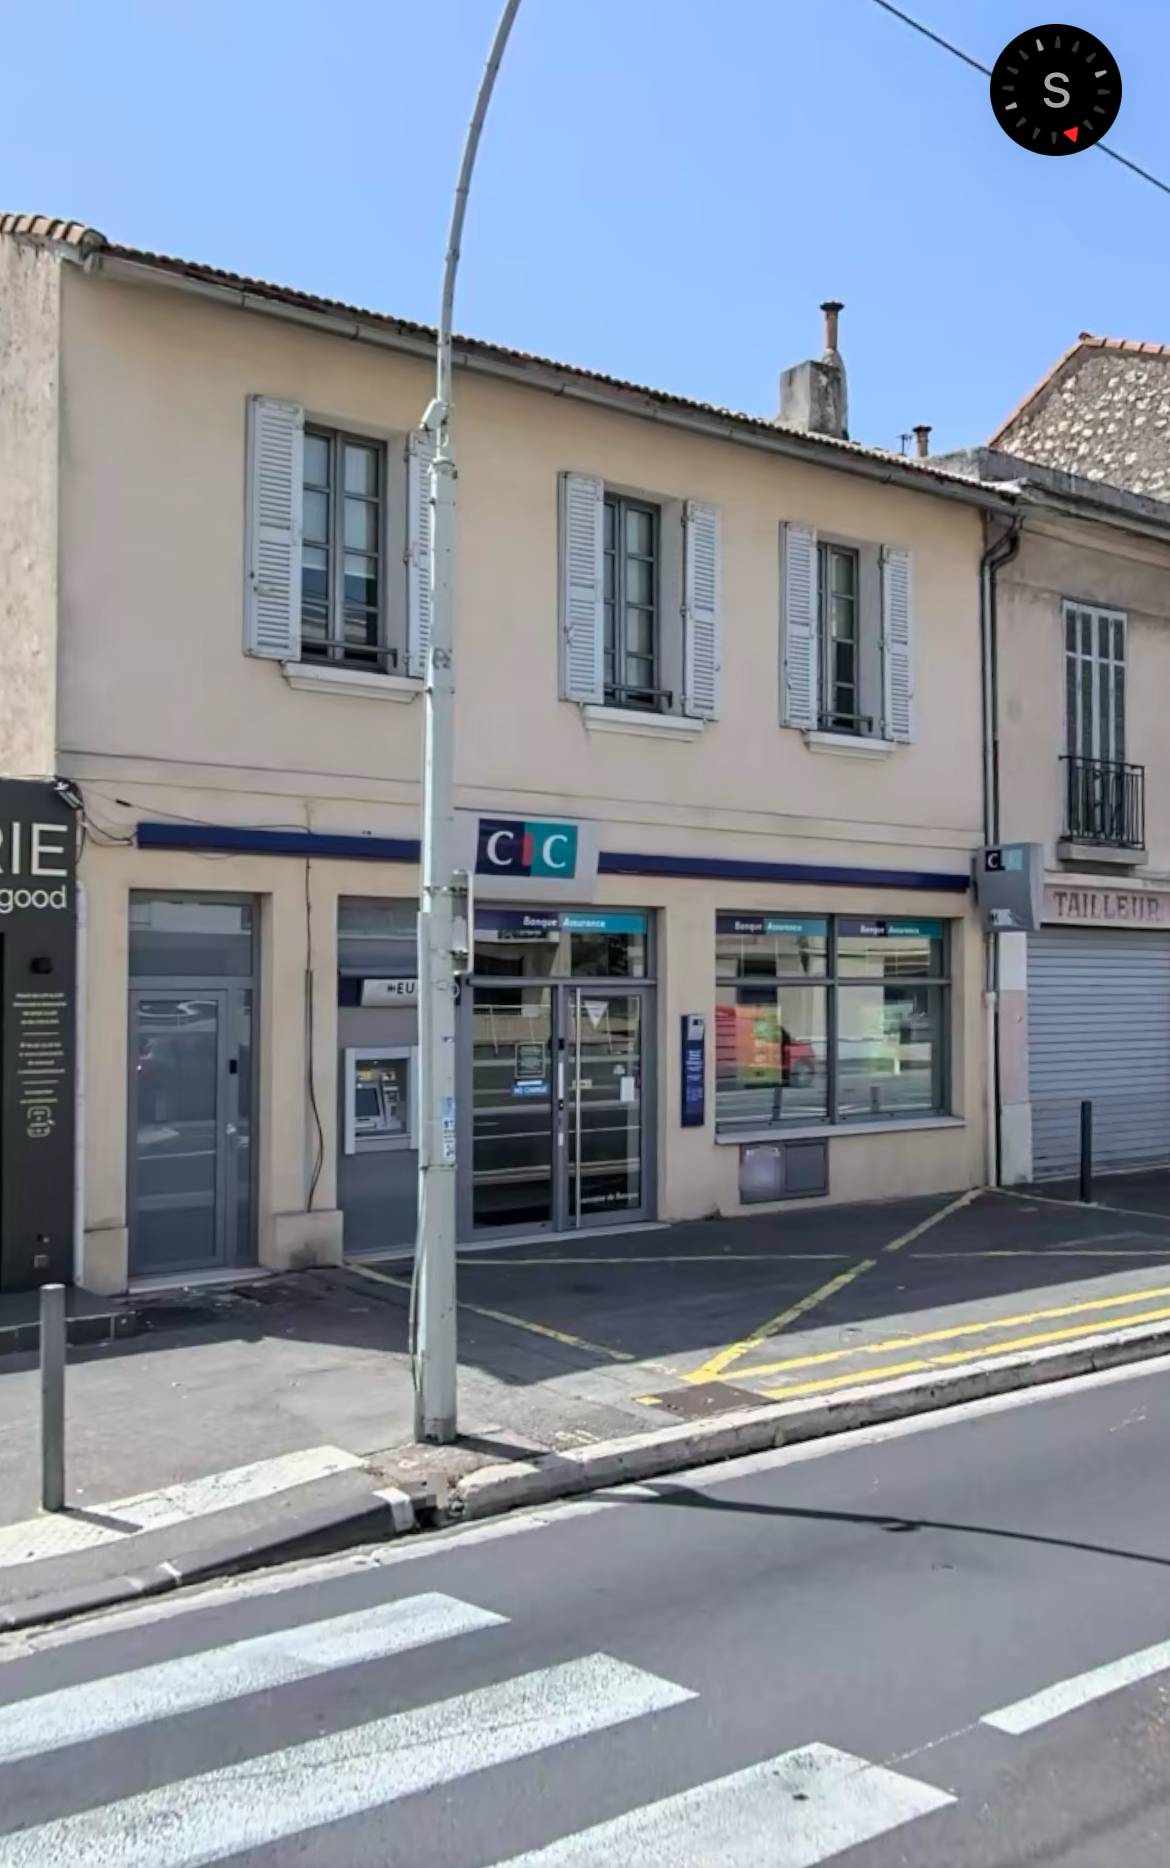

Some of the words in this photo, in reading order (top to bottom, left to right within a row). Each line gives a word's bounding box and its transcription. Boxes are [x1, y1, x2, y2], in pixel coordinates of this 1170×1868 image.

[0, 822, 68, 877] IE
[486, 830, 568, 869] CIC
[0, 884, 67, 914] good
[1053, 891, 1161, 921] TAILLEUR
[522, 916, 558, 928] Banque
[562, 918, 606, 928] Assurance
